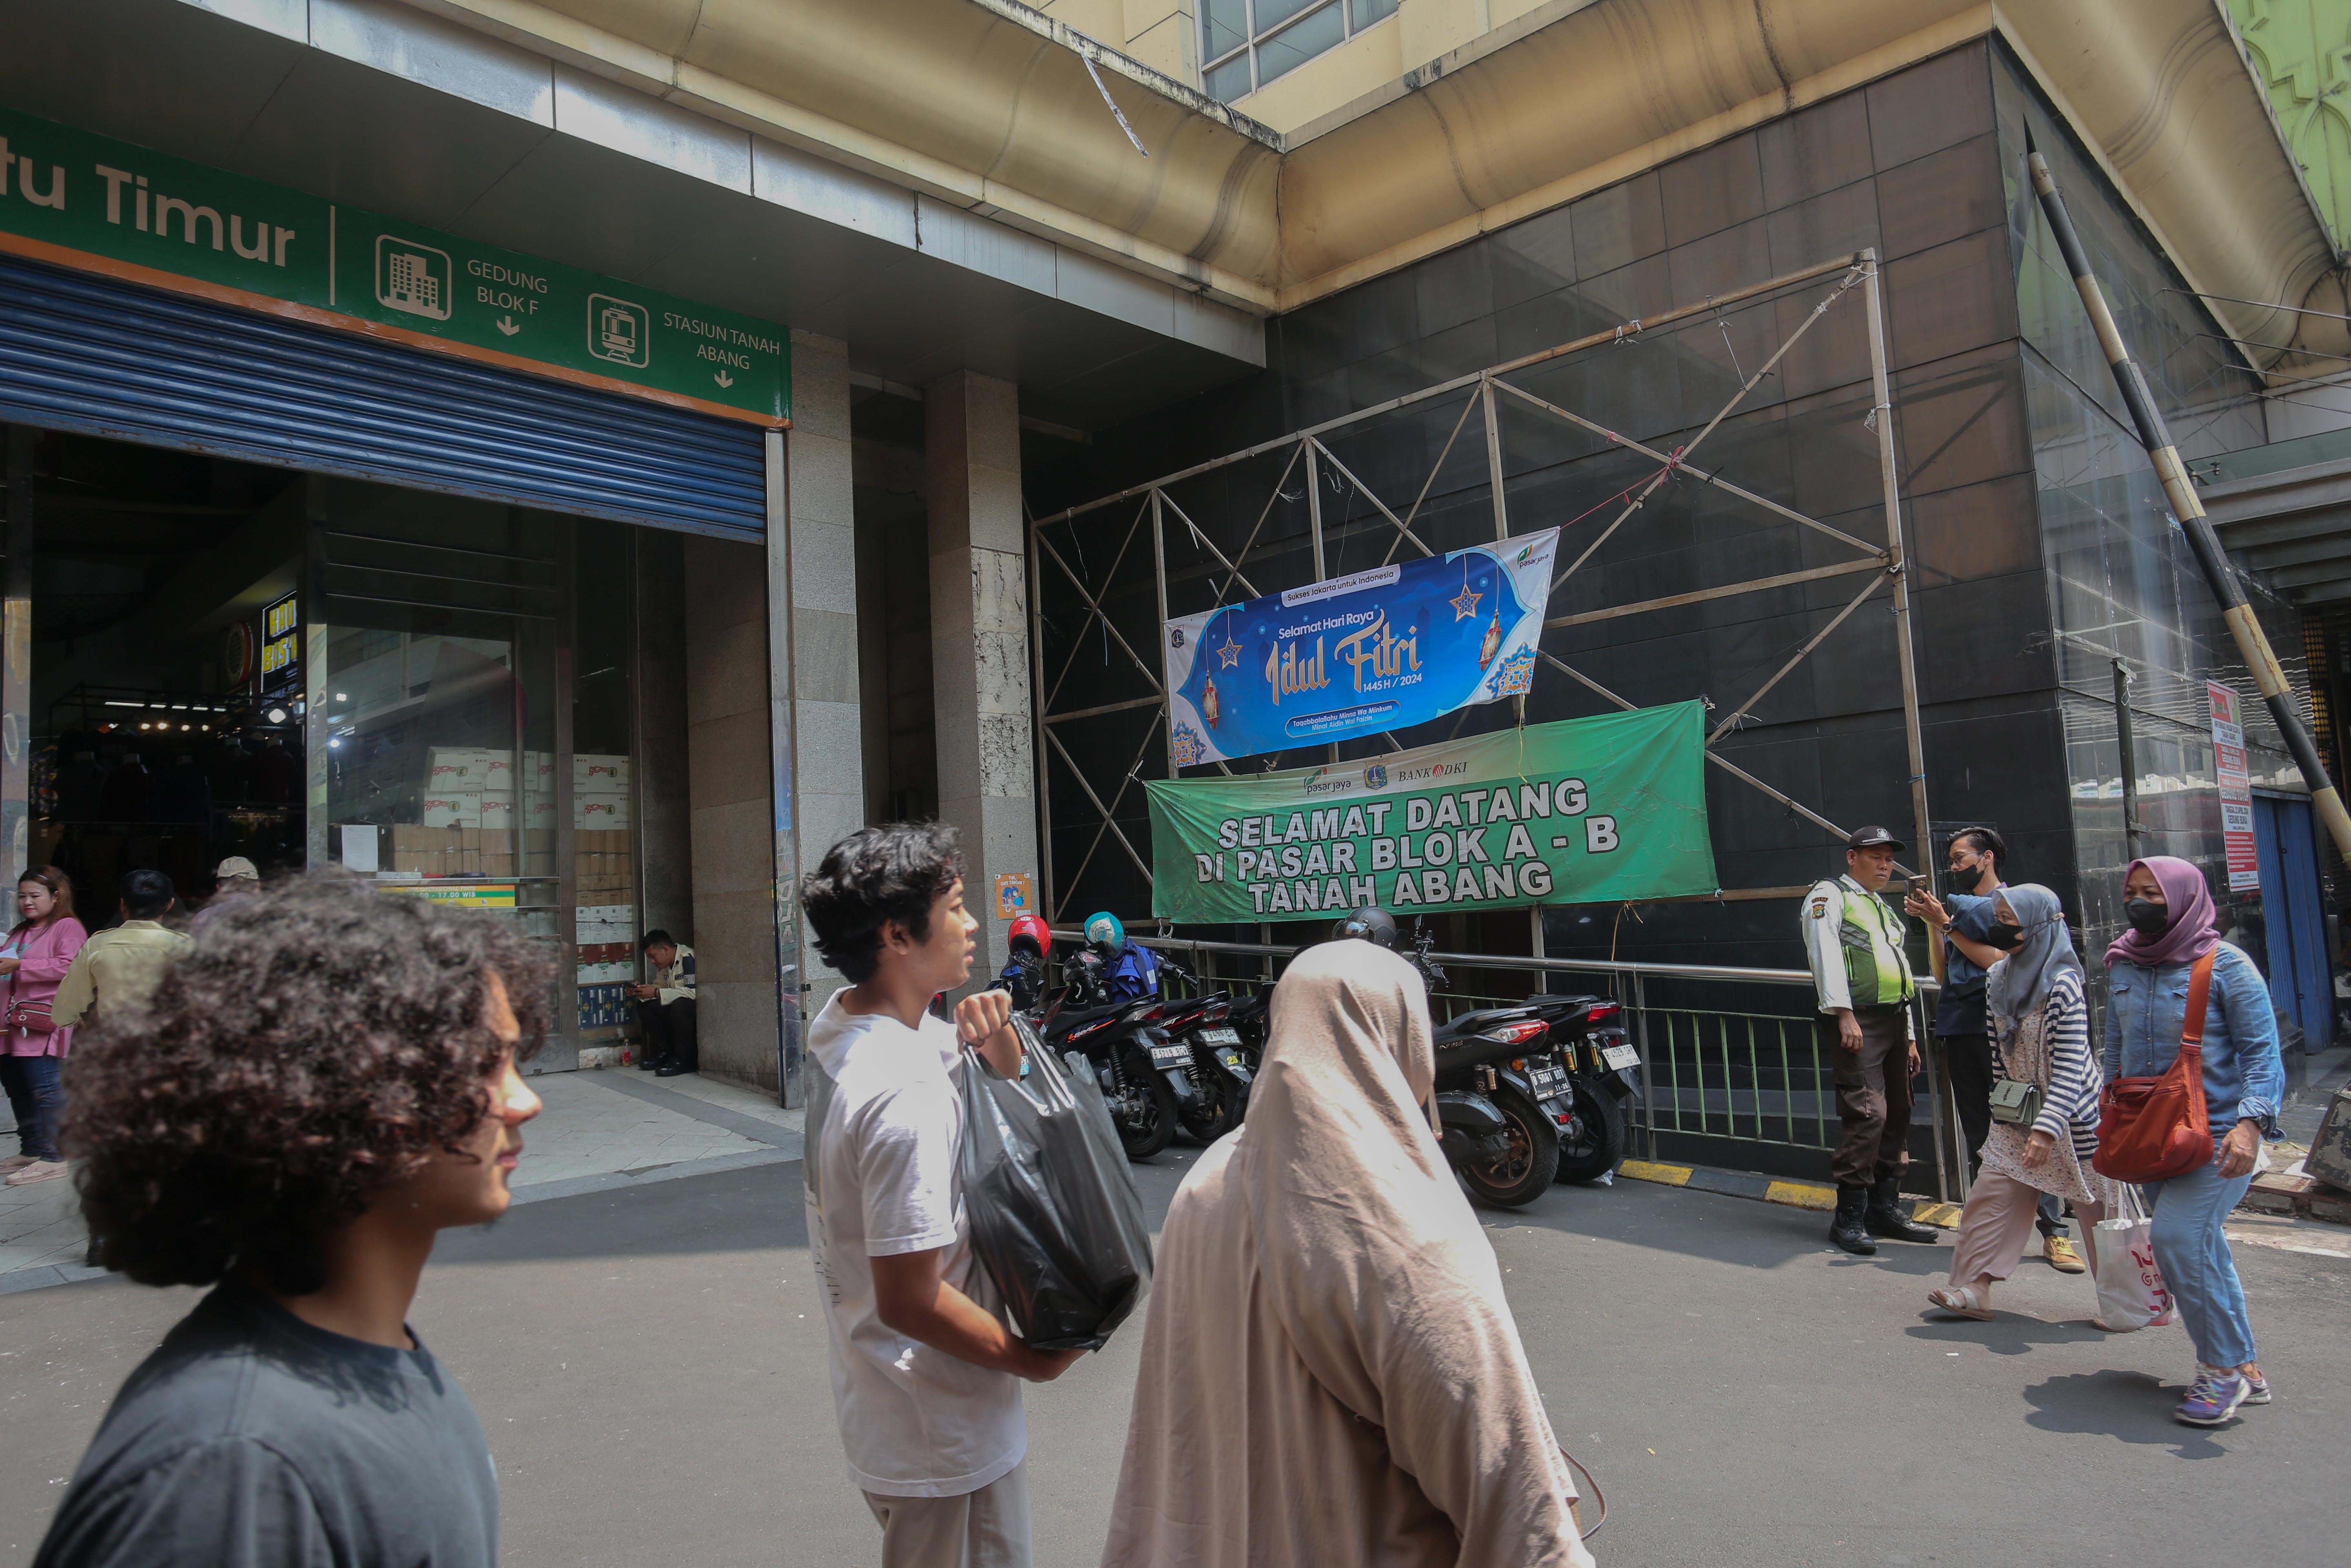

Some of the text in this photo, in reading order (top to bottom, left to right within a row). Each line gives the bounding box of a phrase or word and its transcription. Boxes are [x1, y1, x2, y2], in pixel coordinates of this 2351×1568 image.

[96, 164, 295, 267] Timur
[468, 260, 548, 294] GEDUNG
[478, 286, 539, 315] BLOK F
[664, 312, 780, 355] STASIUN TANAH
[697, 344, 749, 370] ABANG
[1520, 554, 1549, 569] pasar jaya
[1288, 571, 1394, 601] Sukses Jakarta untuk Indonesia
[1278, 610, 1374, 639] Selamat Hari Raya
[1266, 608, 1423, 706] Idul Fitri
[1363, 673, 1422, 693] 1445 H / 2024
[1293, 714, 1338, 727] Taqabbalallahu
[1339, 711, 1356, 719] Minna
[1368, 704, 1392, 714] Minkum
[1312, 722, 1328, 731] Minal
[1329, 719, 1344, 728] Aidin
[1356, 715, 1373, 723] Faizin
[1398, 762, 1467, 782] BANK DKI
[1307, 780, 1351, 795] pasar jaya
[1218, 777, 1589, 850] SELAMAT DATANG
[1194, 815, 1620, 883] DI PASAR BLOK A - B
[1247, 860, 1554, 914] TANAH ABANG
[1153, 1051, 1157, 1059] B
[1159, 1049, 1174, 1058] 5219
[1226, 1056, 1238, 1065] 25
[1605, 1046, 1634, 1060] B 4529 SRP
[1532, 1076, 1538, 1086] B
[1538, 1072, 1553, 1084] 5081
